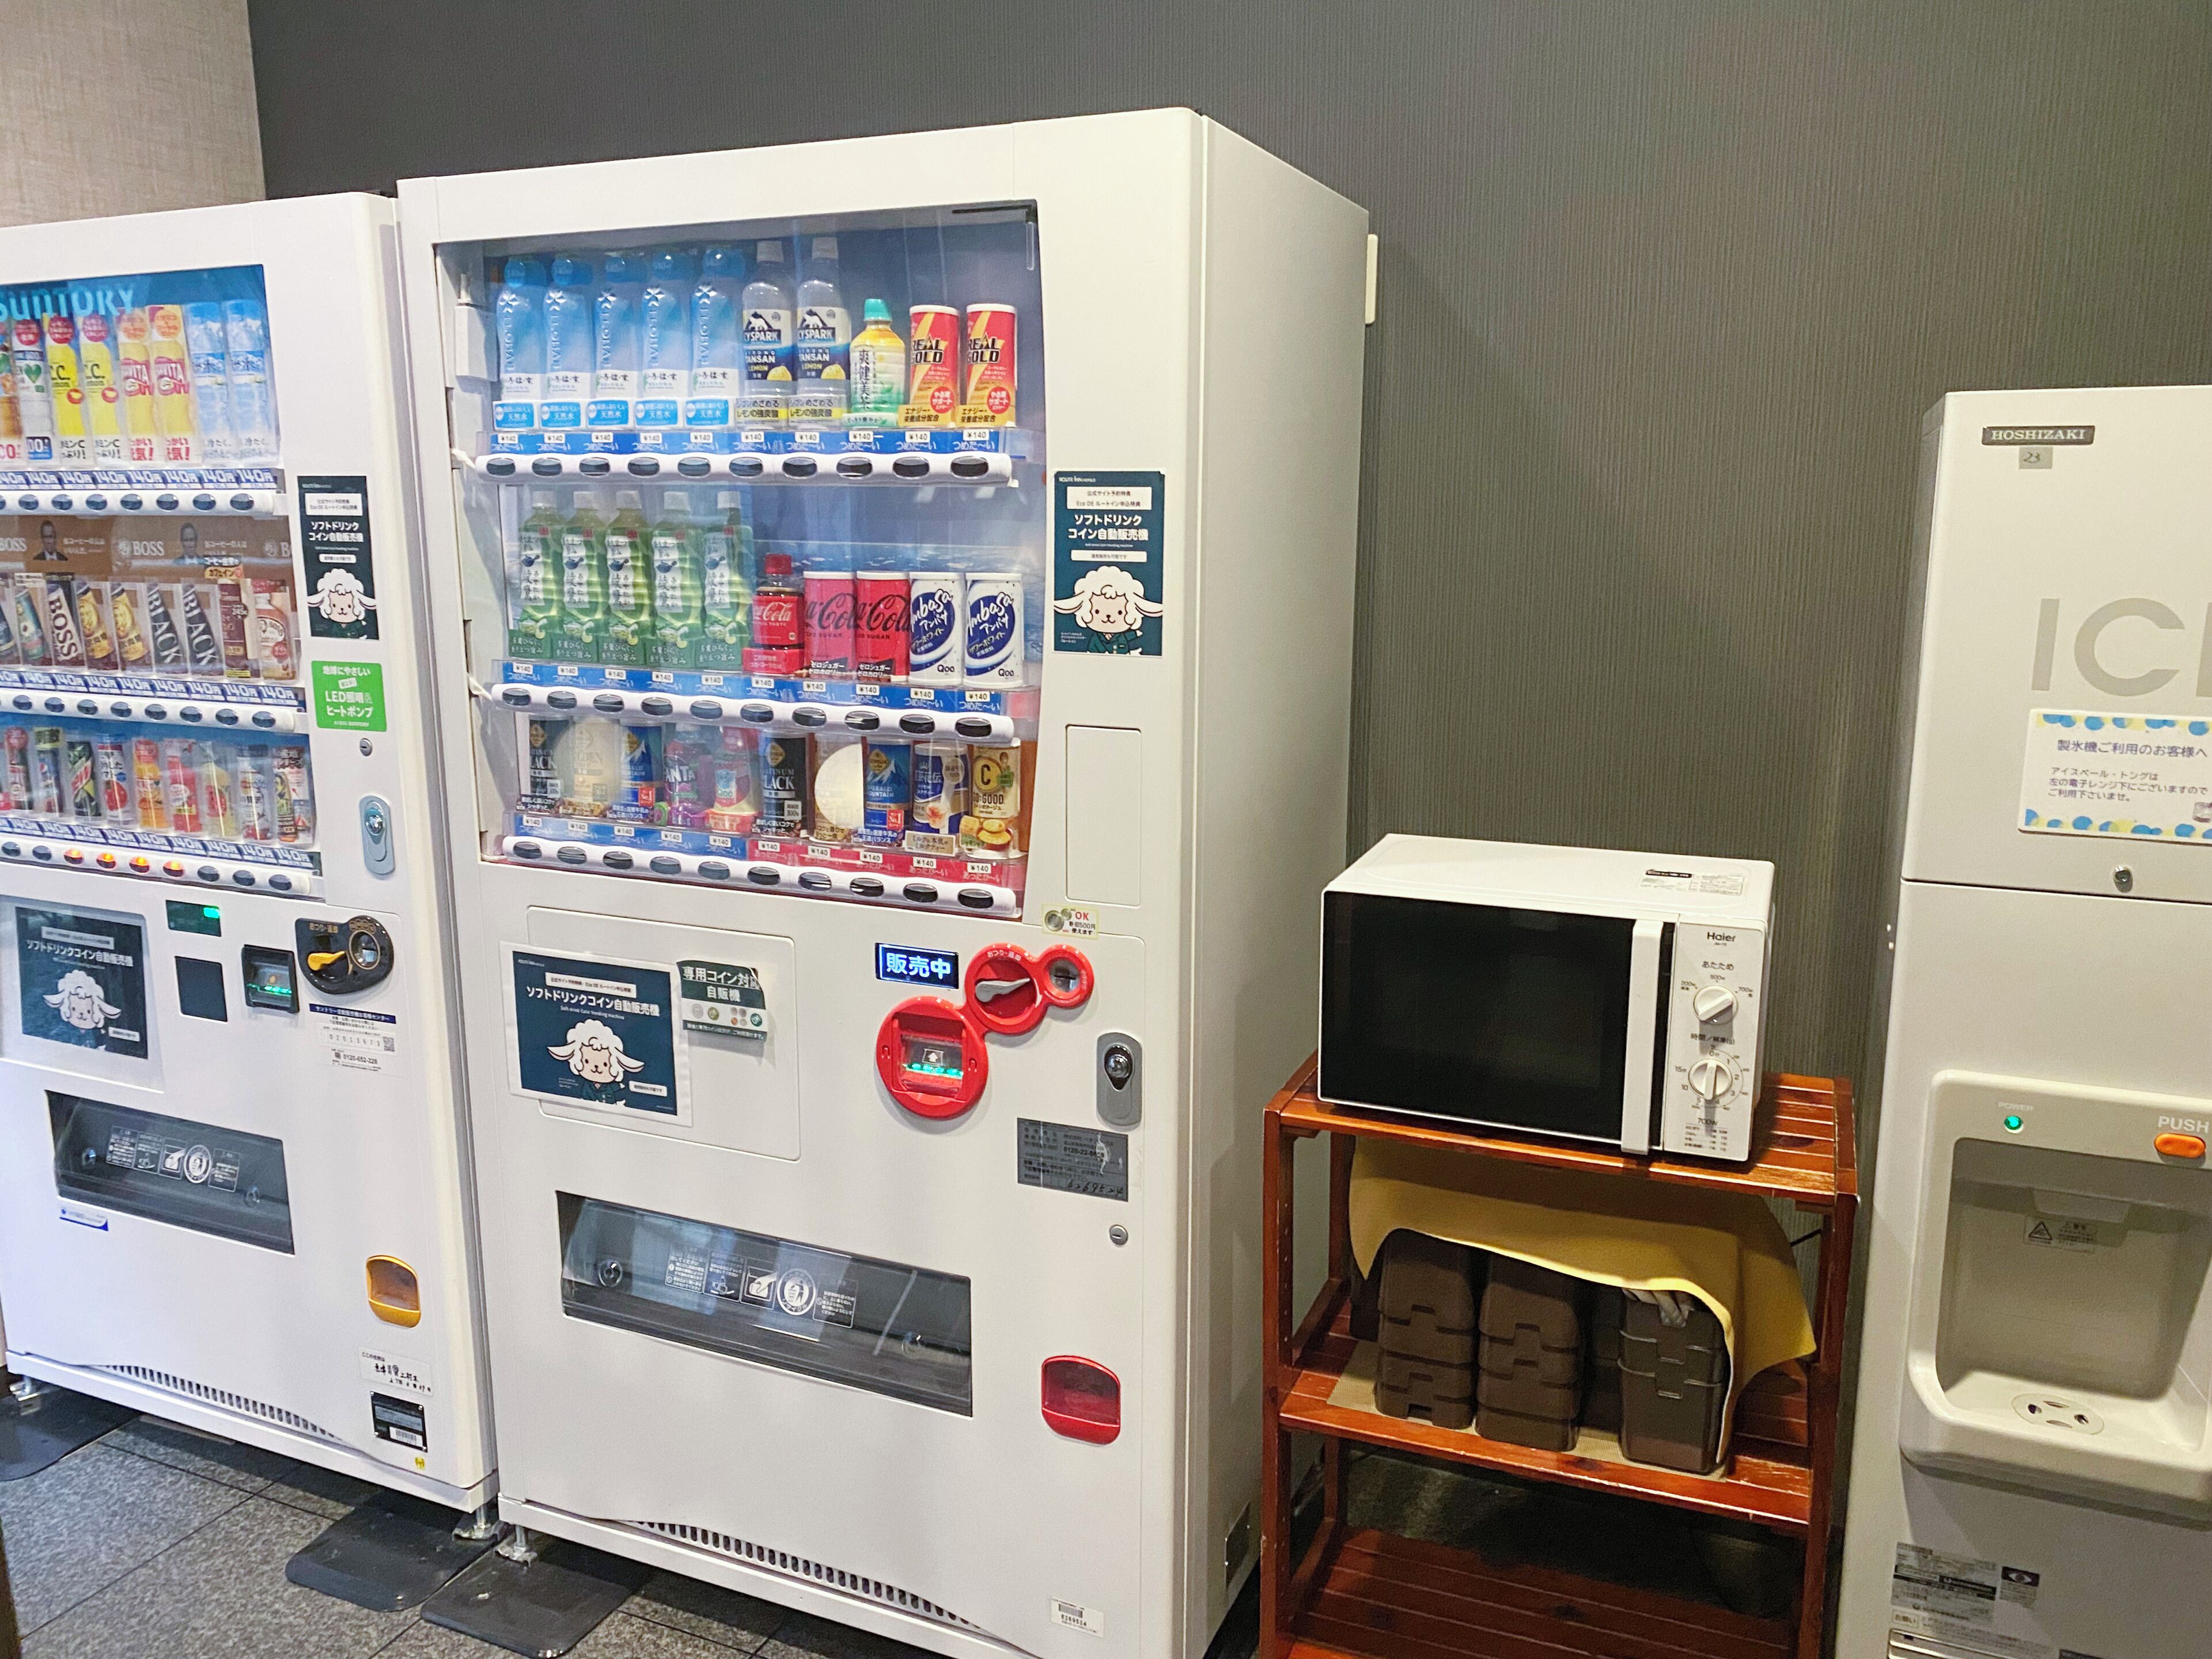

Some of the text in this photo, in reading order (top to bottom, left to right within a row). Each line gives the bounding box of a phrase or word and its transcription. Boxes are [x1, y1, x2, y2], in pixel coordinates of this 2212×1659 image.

[858, 349, 871, 414] 爽健美茶
[904, 414, 939, 422] 栄養成分配合
[961, 414, 996, 423] 栄養成分配合
[1990, 429, 2086, 441] HOSHIZAKI
[311, 521, 359, 531] ソフトドリンク
[1074, 514, 1142, 527] ソフトドリンク
[309, 532, 363, 543] コイン自動販売機
[1068, 528, 1149, 541] コイン自動販売機
[132, 540, 164, 556] BOSS
[762, 602, 792, 622] Cola
[911, 588, 953, 634] mbasa
[810, 660, 845, 669] ゼロシュガー
[859, 664, 891, 672] ゼロシュガー
[937, 664, 955, 673] Qoo
[998, 668, 1014, 677] Qoo
[2056, 738, 2209, 758] 製氷機ご利用のお客様へ
[665, 766, 696, 783] ANTA
[980, 764, 991, 786] C
[2051, 767, 2158, 781] アイスペール・トングは
[764, 775, 796, 790] LACK
[2049, 778, 2209, 796] 左の電子レンジ下にございますので
[2047, 788, 2131, 802] ご利用下さいませ。
[863, 854, 880, 862] ¥140
[916, 859, 934, 867] ¥140
[1075, 911, 1089, 921] OK
[1707, 931, 1736, 942] Haier
[886, 952, 951, 980] 販売中
[1702, 960, 1734, 971] あたため
[707, 985, 741, 1003] 自販機
[526, 986, 660, 1017] ソフトドリンクコイン自動販売機
[751, 1014, 762, 1025] OK
[1998, 1101, 2034, 1112] POWER
[2158, 1115, 2210, 1134] PUSH
